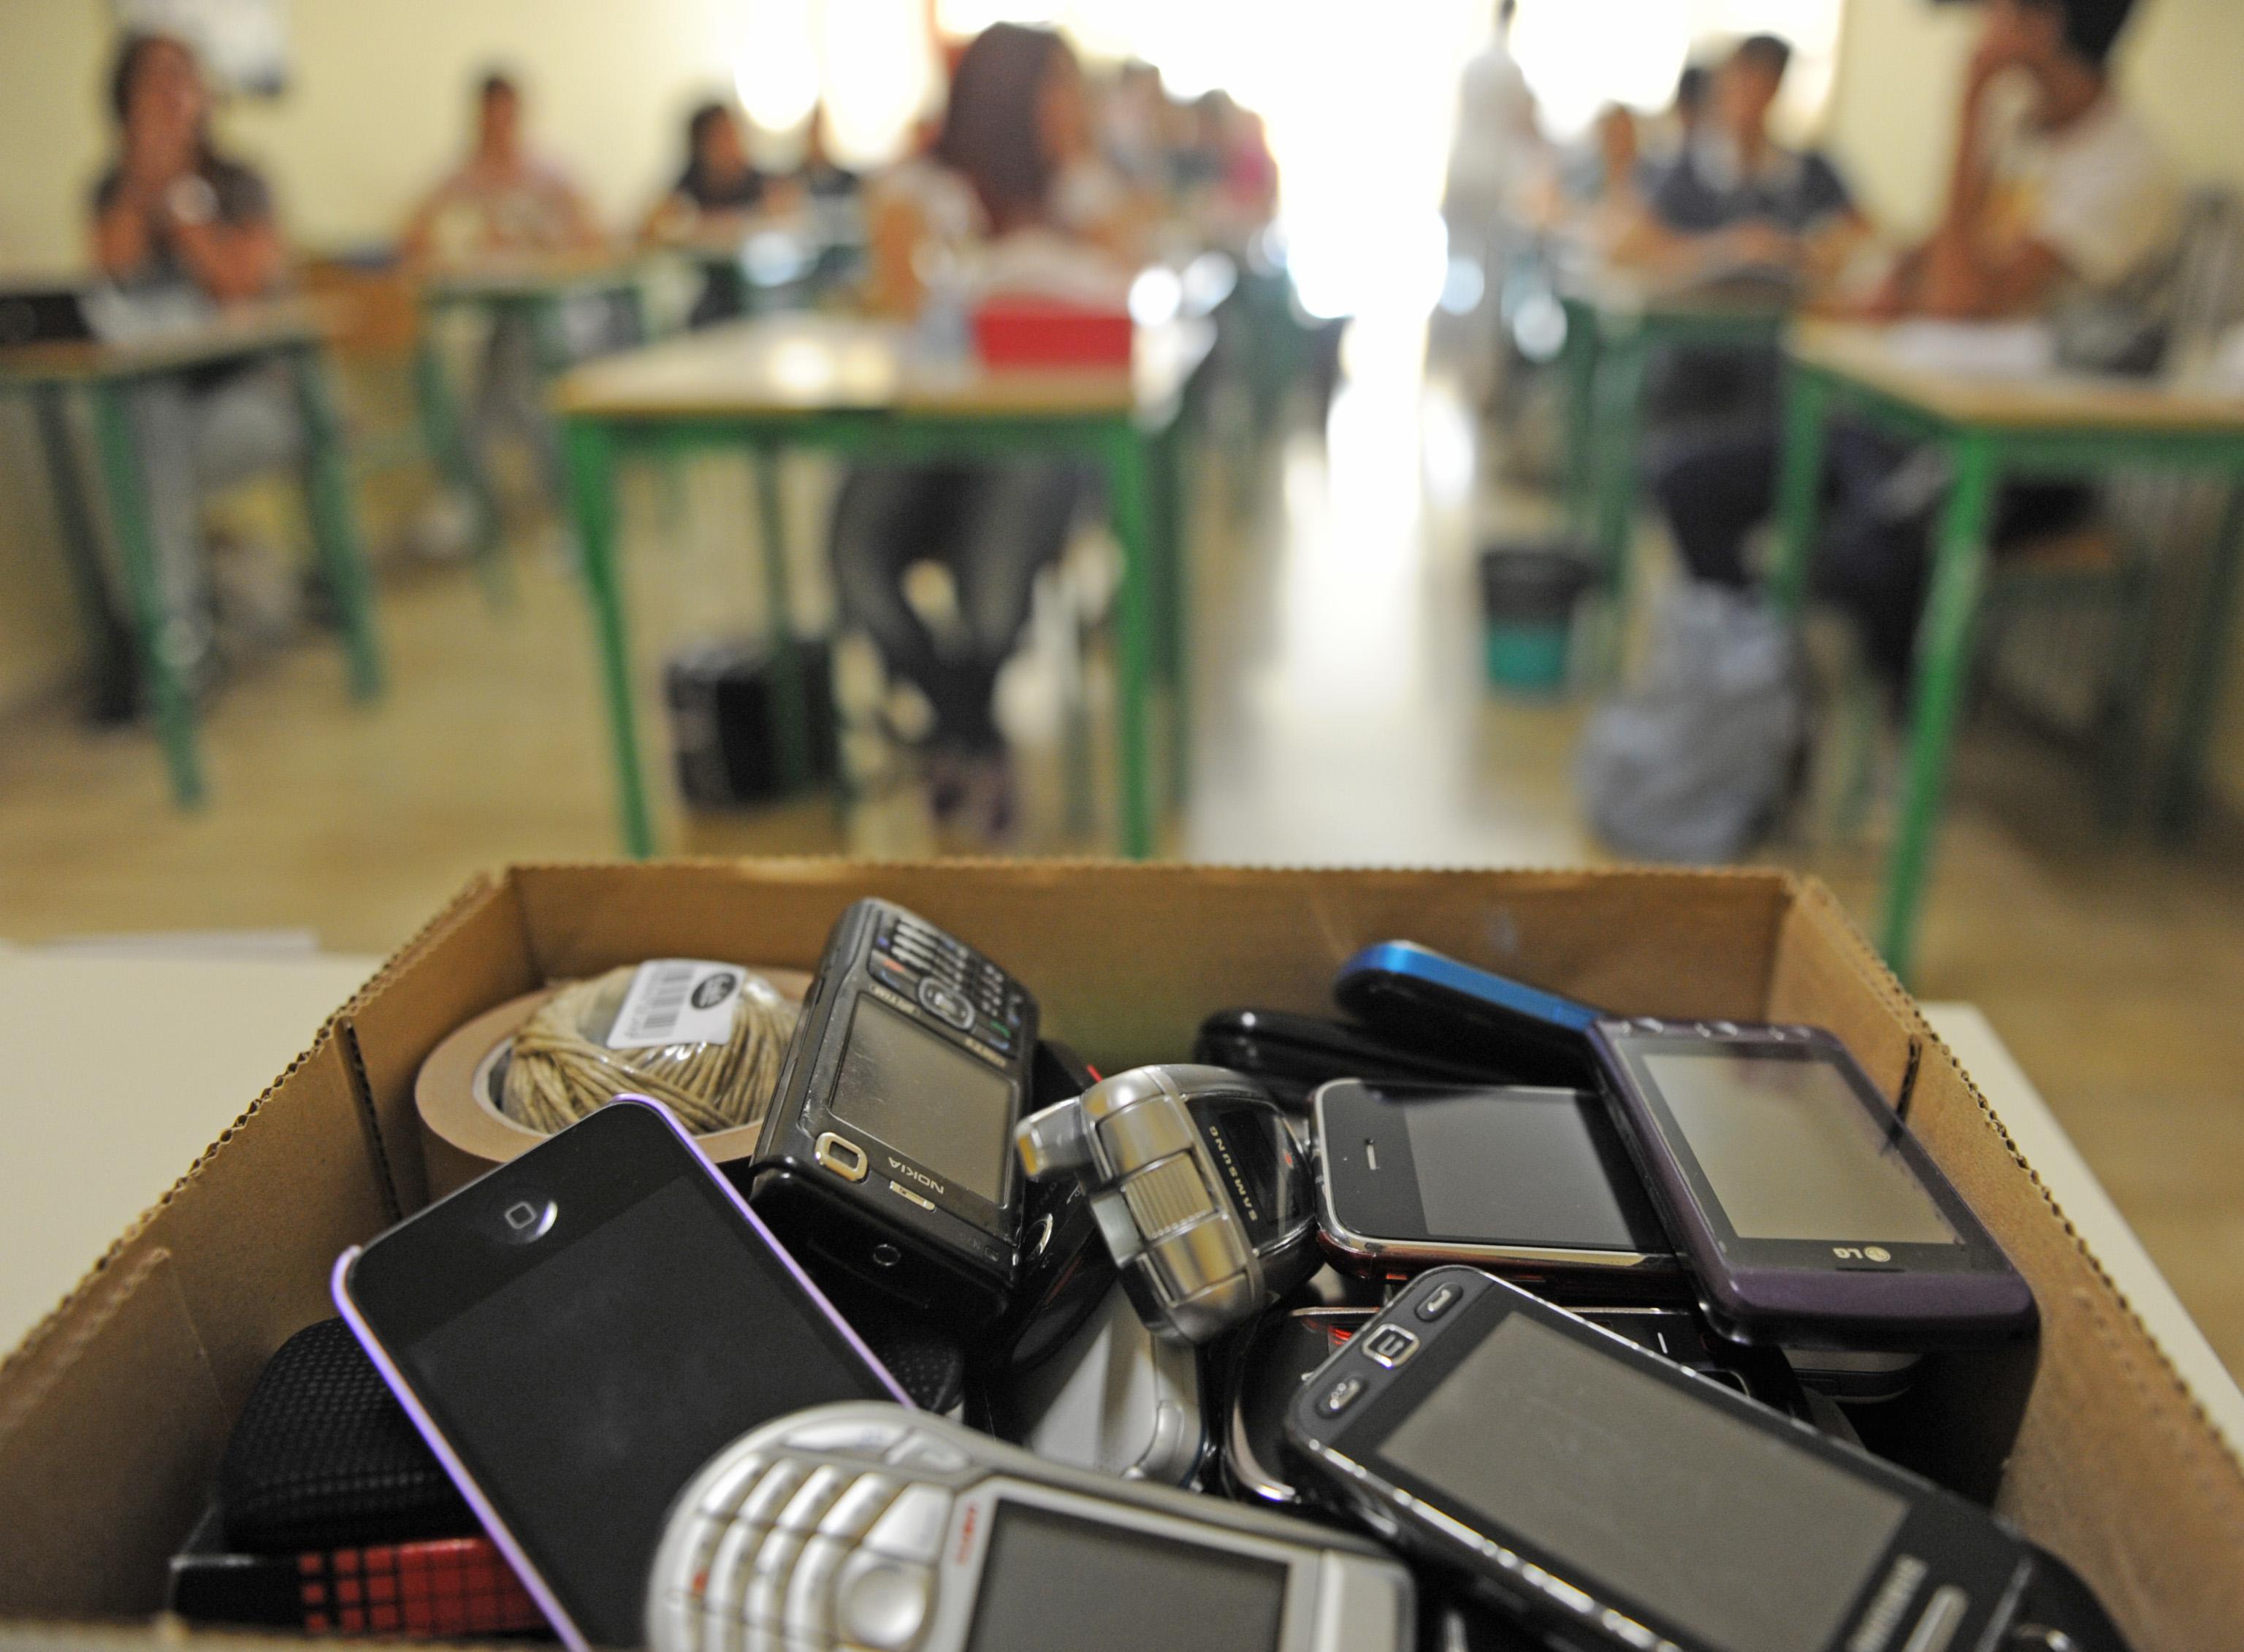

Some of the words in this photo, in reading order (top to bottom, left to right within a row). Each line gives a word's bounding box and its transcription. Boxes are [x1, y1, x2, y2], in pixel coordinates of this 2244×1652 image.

[888, 1157, 944, 1194] NOKIA
[1210, 1126, 1257, 1220] SAMSUNG
[1833, 1247, 1863, 1259] LG
